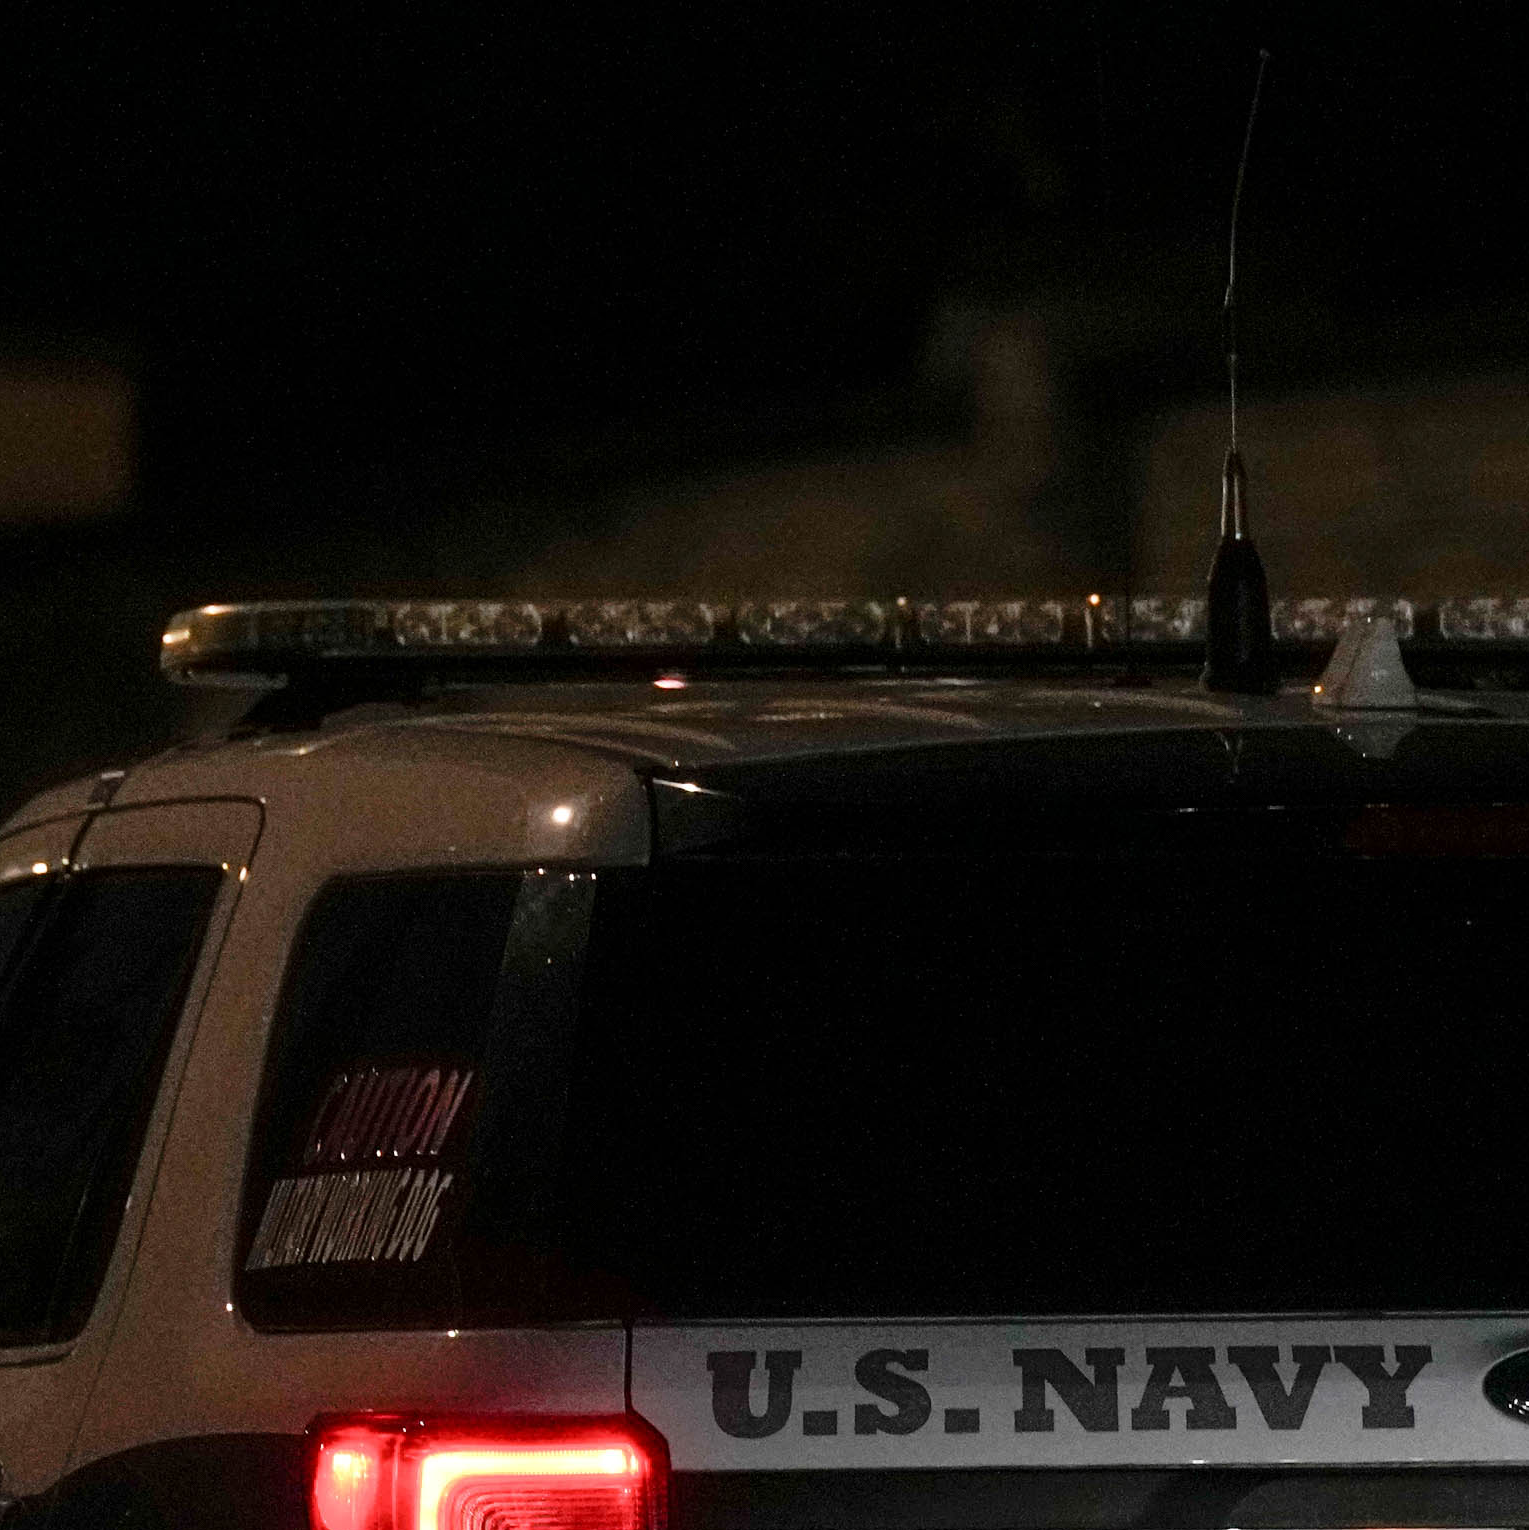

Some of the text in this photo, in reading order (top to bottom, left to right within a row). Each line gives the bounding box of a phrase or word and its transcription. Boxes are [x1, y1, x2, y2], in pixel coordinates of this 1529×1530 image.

[384, 1168, 454, 1262] DOG
[706, 1344, 1433, 1439] U.S. NAVY
